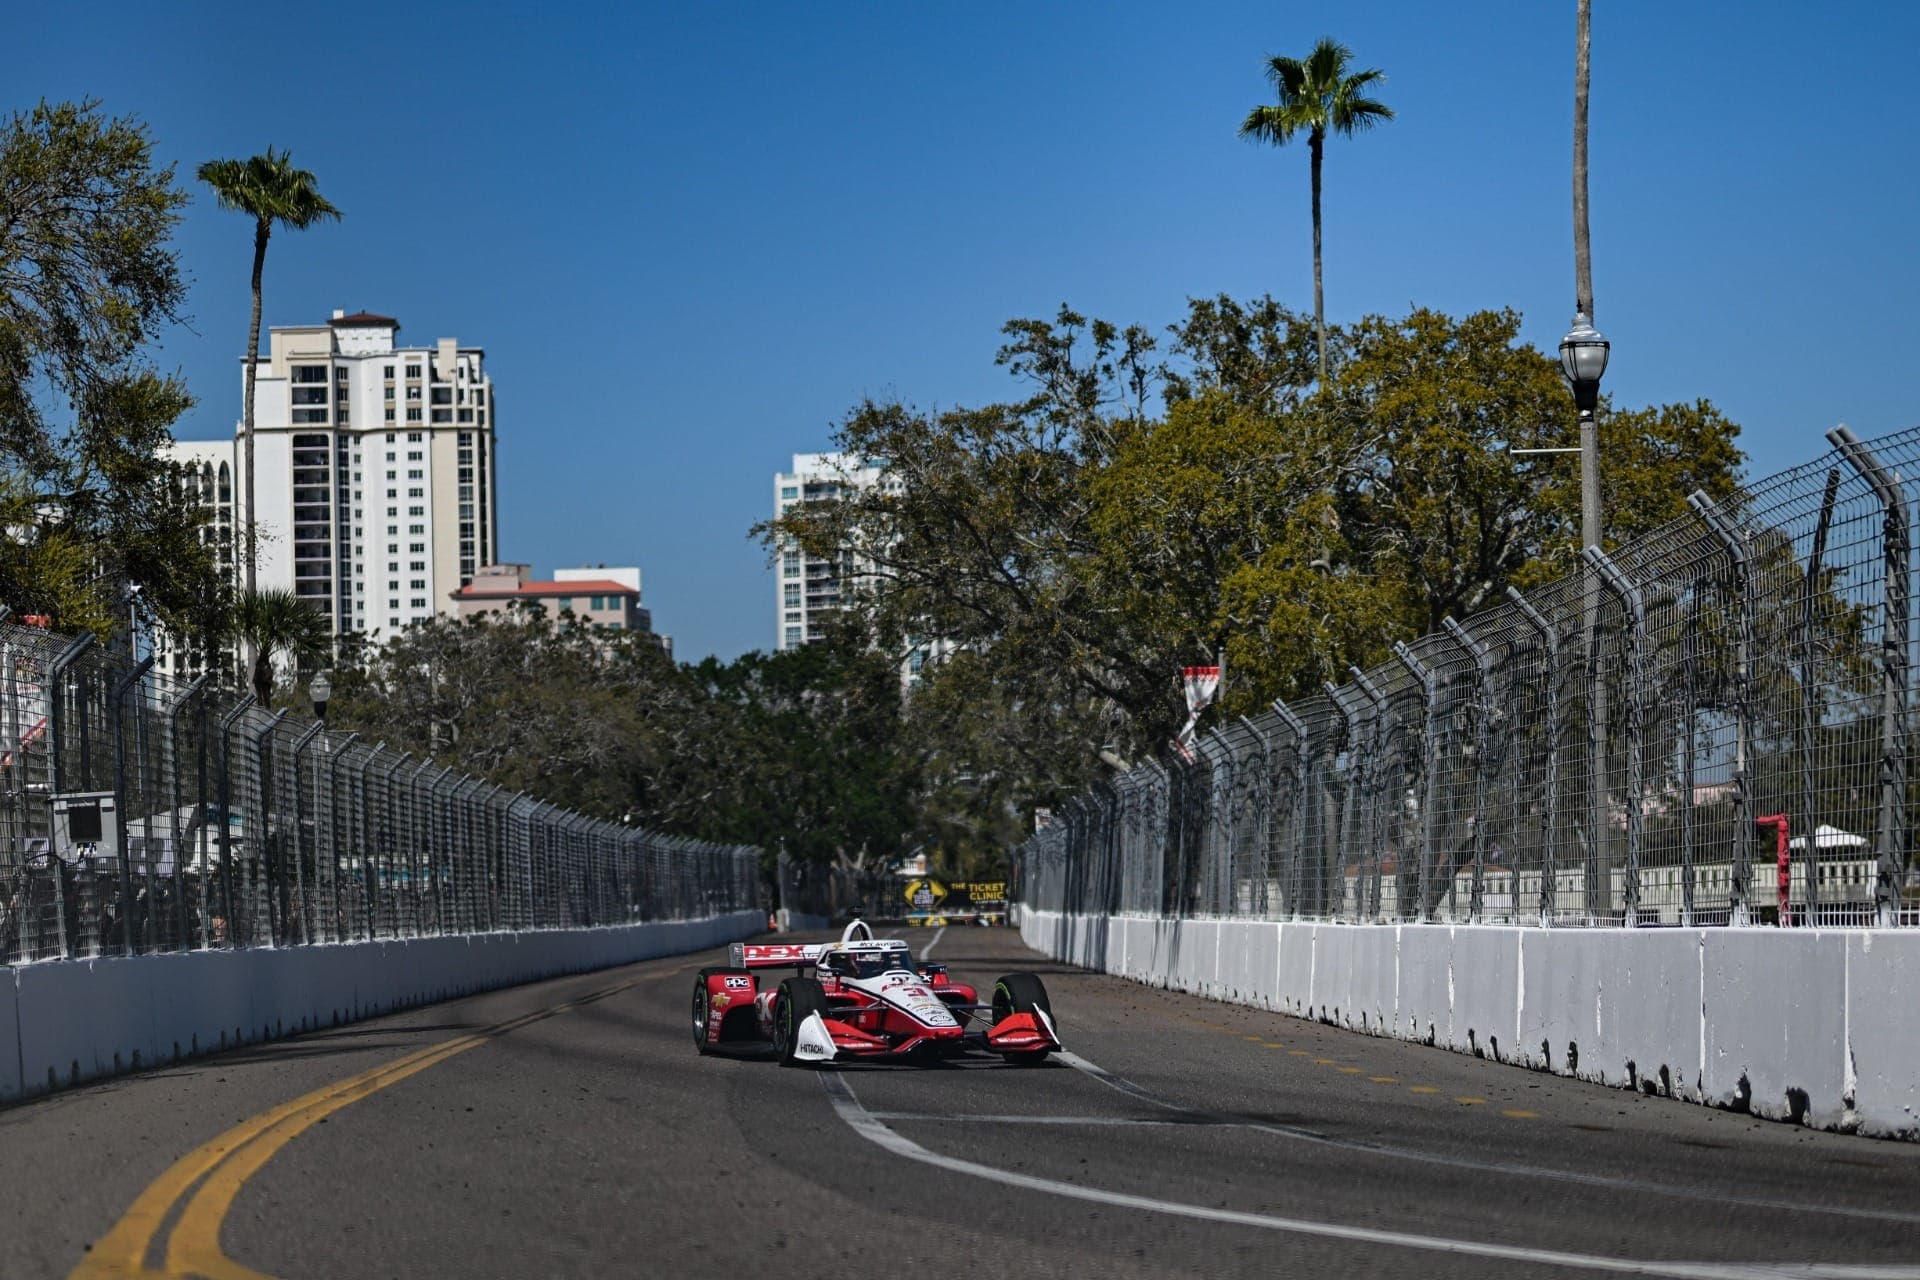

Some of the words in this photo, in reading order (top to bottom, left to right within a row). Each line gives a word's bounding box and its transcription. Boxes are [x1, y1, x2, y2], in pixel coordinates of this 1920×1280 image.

[969, 882, 1005, 892] TICKET
[969, 892, 1004, 900] CLINIC
[800, 1044, 824, 1054] HITACHI
